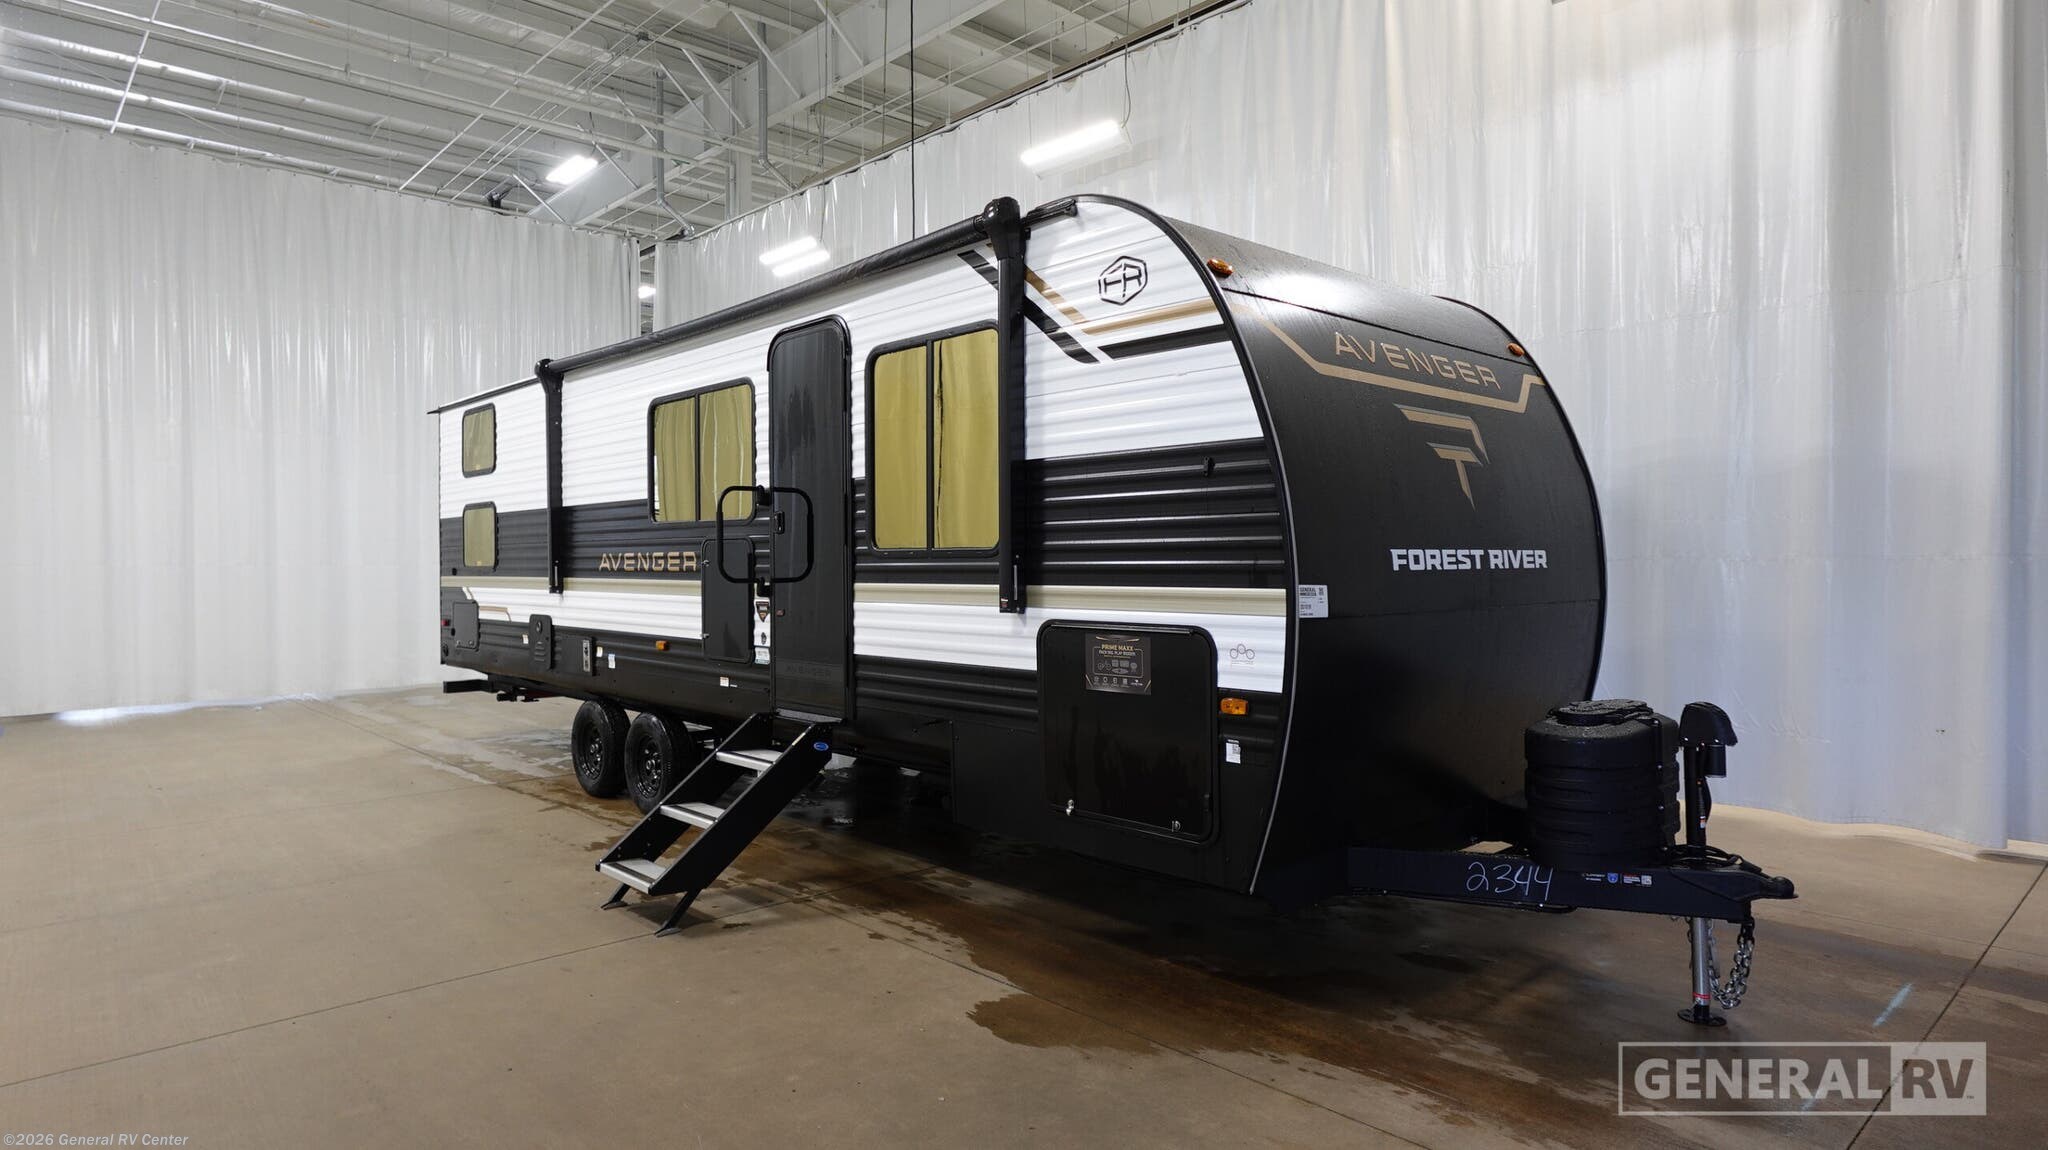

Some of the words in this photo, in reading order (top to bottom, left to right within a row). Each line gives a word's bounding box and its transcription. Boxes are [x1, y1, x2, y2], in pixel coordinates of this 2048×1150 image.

[1335, 331, 1501, 390] AVENGER
[599, 551, 697, 571] AVENGER
[1390, 549, 1485, 571] FOREST
[1488, 550, 1548, 569] RIVER
[1466, 861, 1554, 901] 2344
